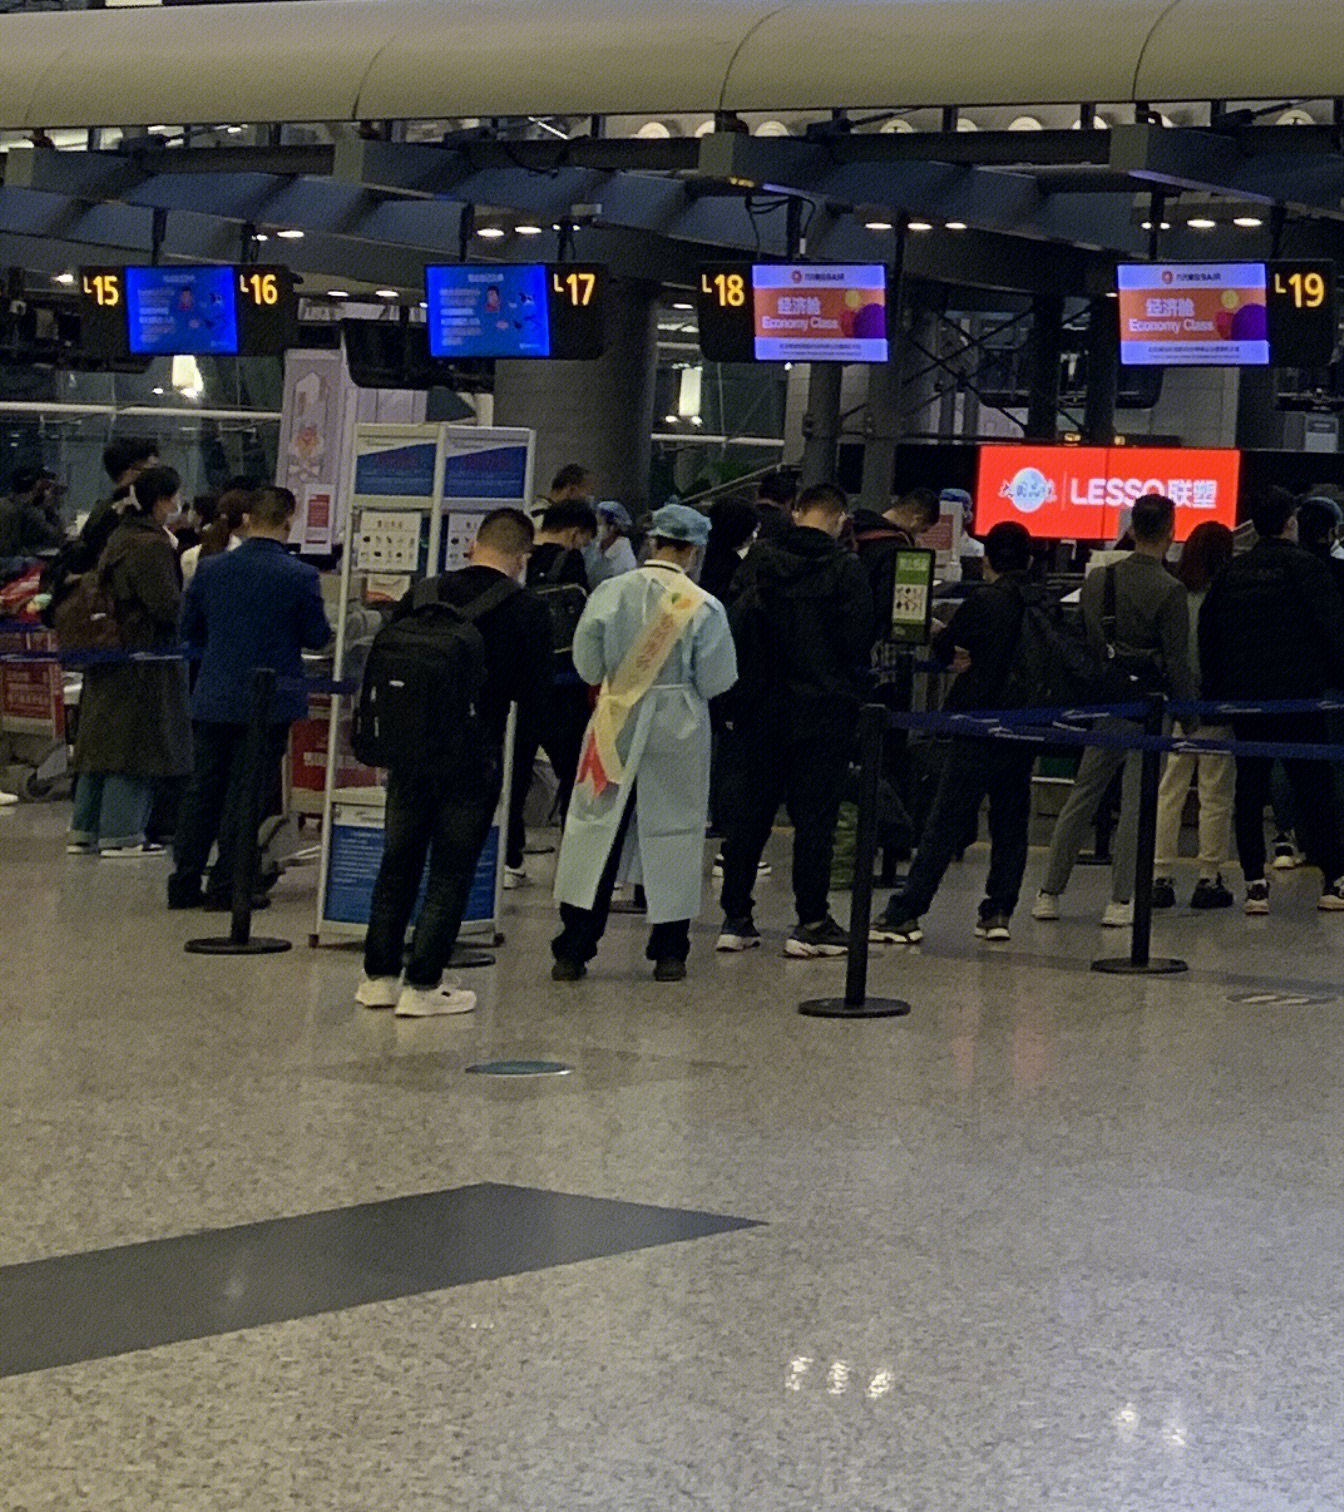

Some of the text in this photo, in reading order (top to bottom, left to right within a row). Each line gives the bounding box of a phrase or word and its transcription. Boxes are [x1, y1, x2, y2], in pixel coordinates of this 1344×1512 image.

[83, 275, 120, 307] L15
[239, 274, 278, 305] L16
[553, 273, 596, 306] L17
[701, 273, 745, 307] L18
[1275, 272, 1325, 308] L19
[1129, 319, 1215, 334] Economy Class
